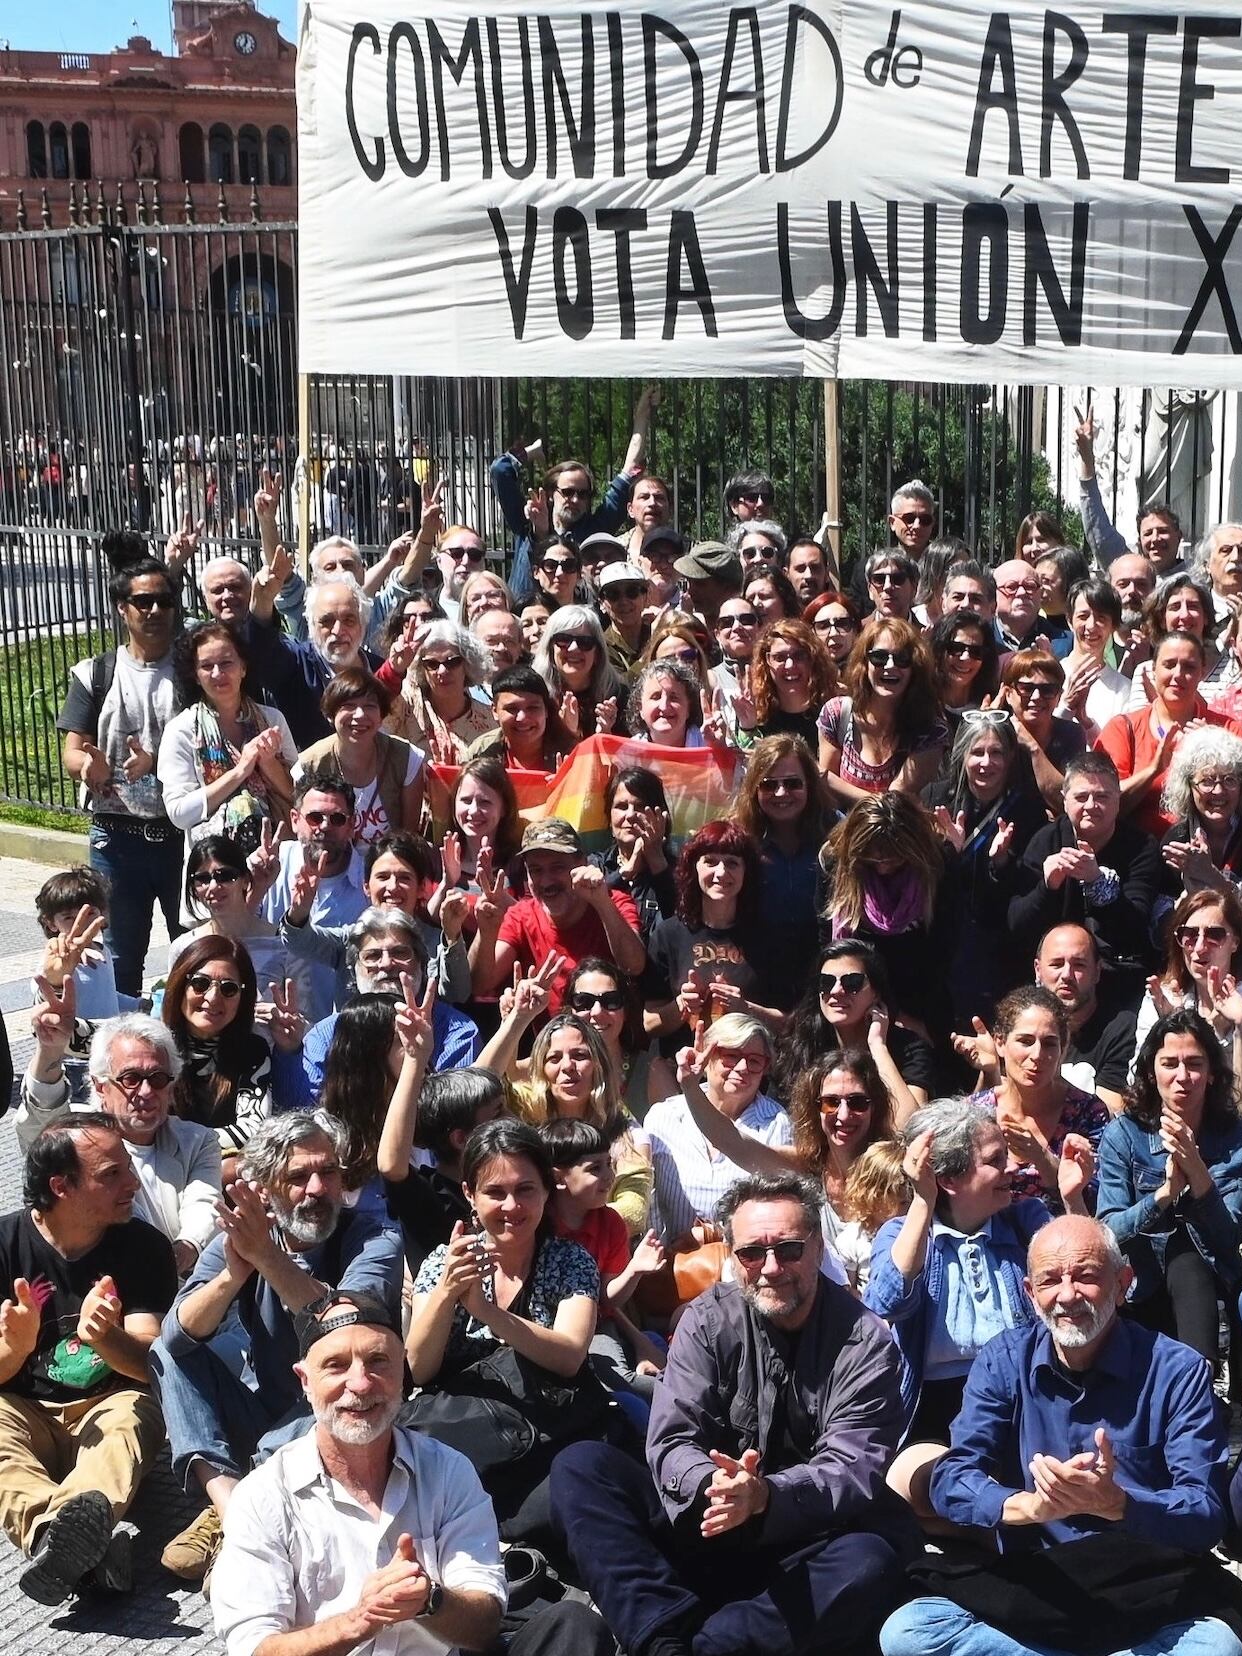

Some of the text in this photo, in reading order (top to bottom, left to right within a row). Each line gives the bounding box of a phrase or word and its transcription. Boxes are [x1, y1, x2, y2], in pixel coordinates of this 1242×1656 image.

[345, 5, 843, 182] COMUNIDAD
[864, 10, 923, 89] de
[488, 204, 718, 341] VOTA
[777, 185, 1089, 347] UNIÓN
